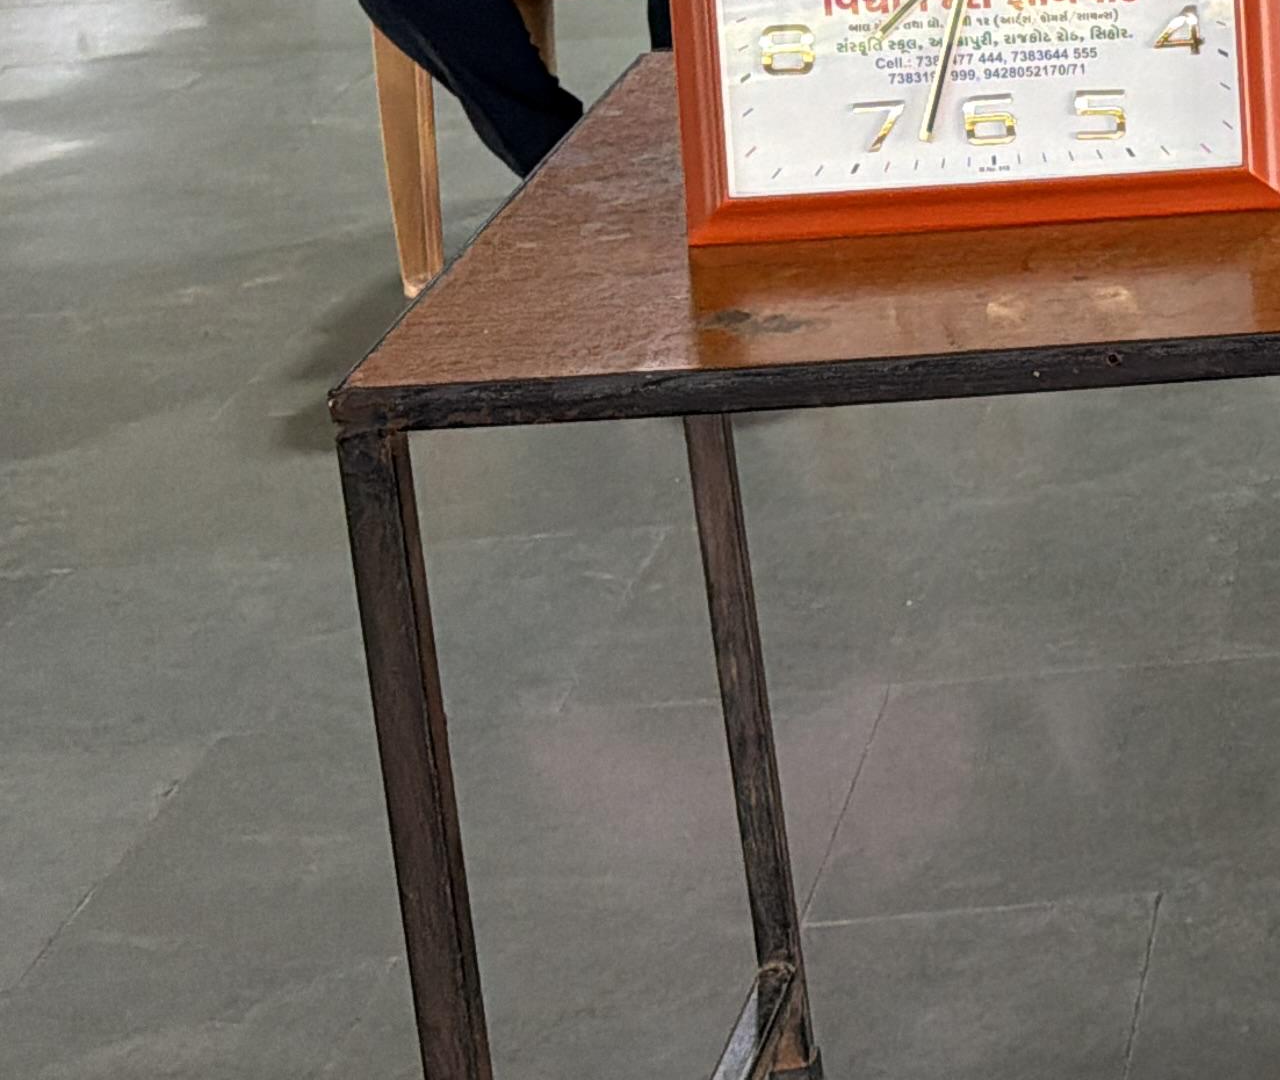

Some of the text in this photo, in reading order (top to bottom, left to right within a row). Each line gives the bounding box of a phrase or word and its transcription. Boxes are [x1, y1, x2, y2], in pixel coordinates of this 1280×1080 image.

[759, 23, 816, 76] 8
[1011, 48, 1069, 63] 7383644
[1073, 47, 1098, 60] 555
[1154, 6, 1204, 56] 4
[984, 63, 1086, 79] 9428052170/71
[851, 100, 904, 152] 7
[962, 92, 1017, 146] 6
[1074, 88, 1126, 141] 5
